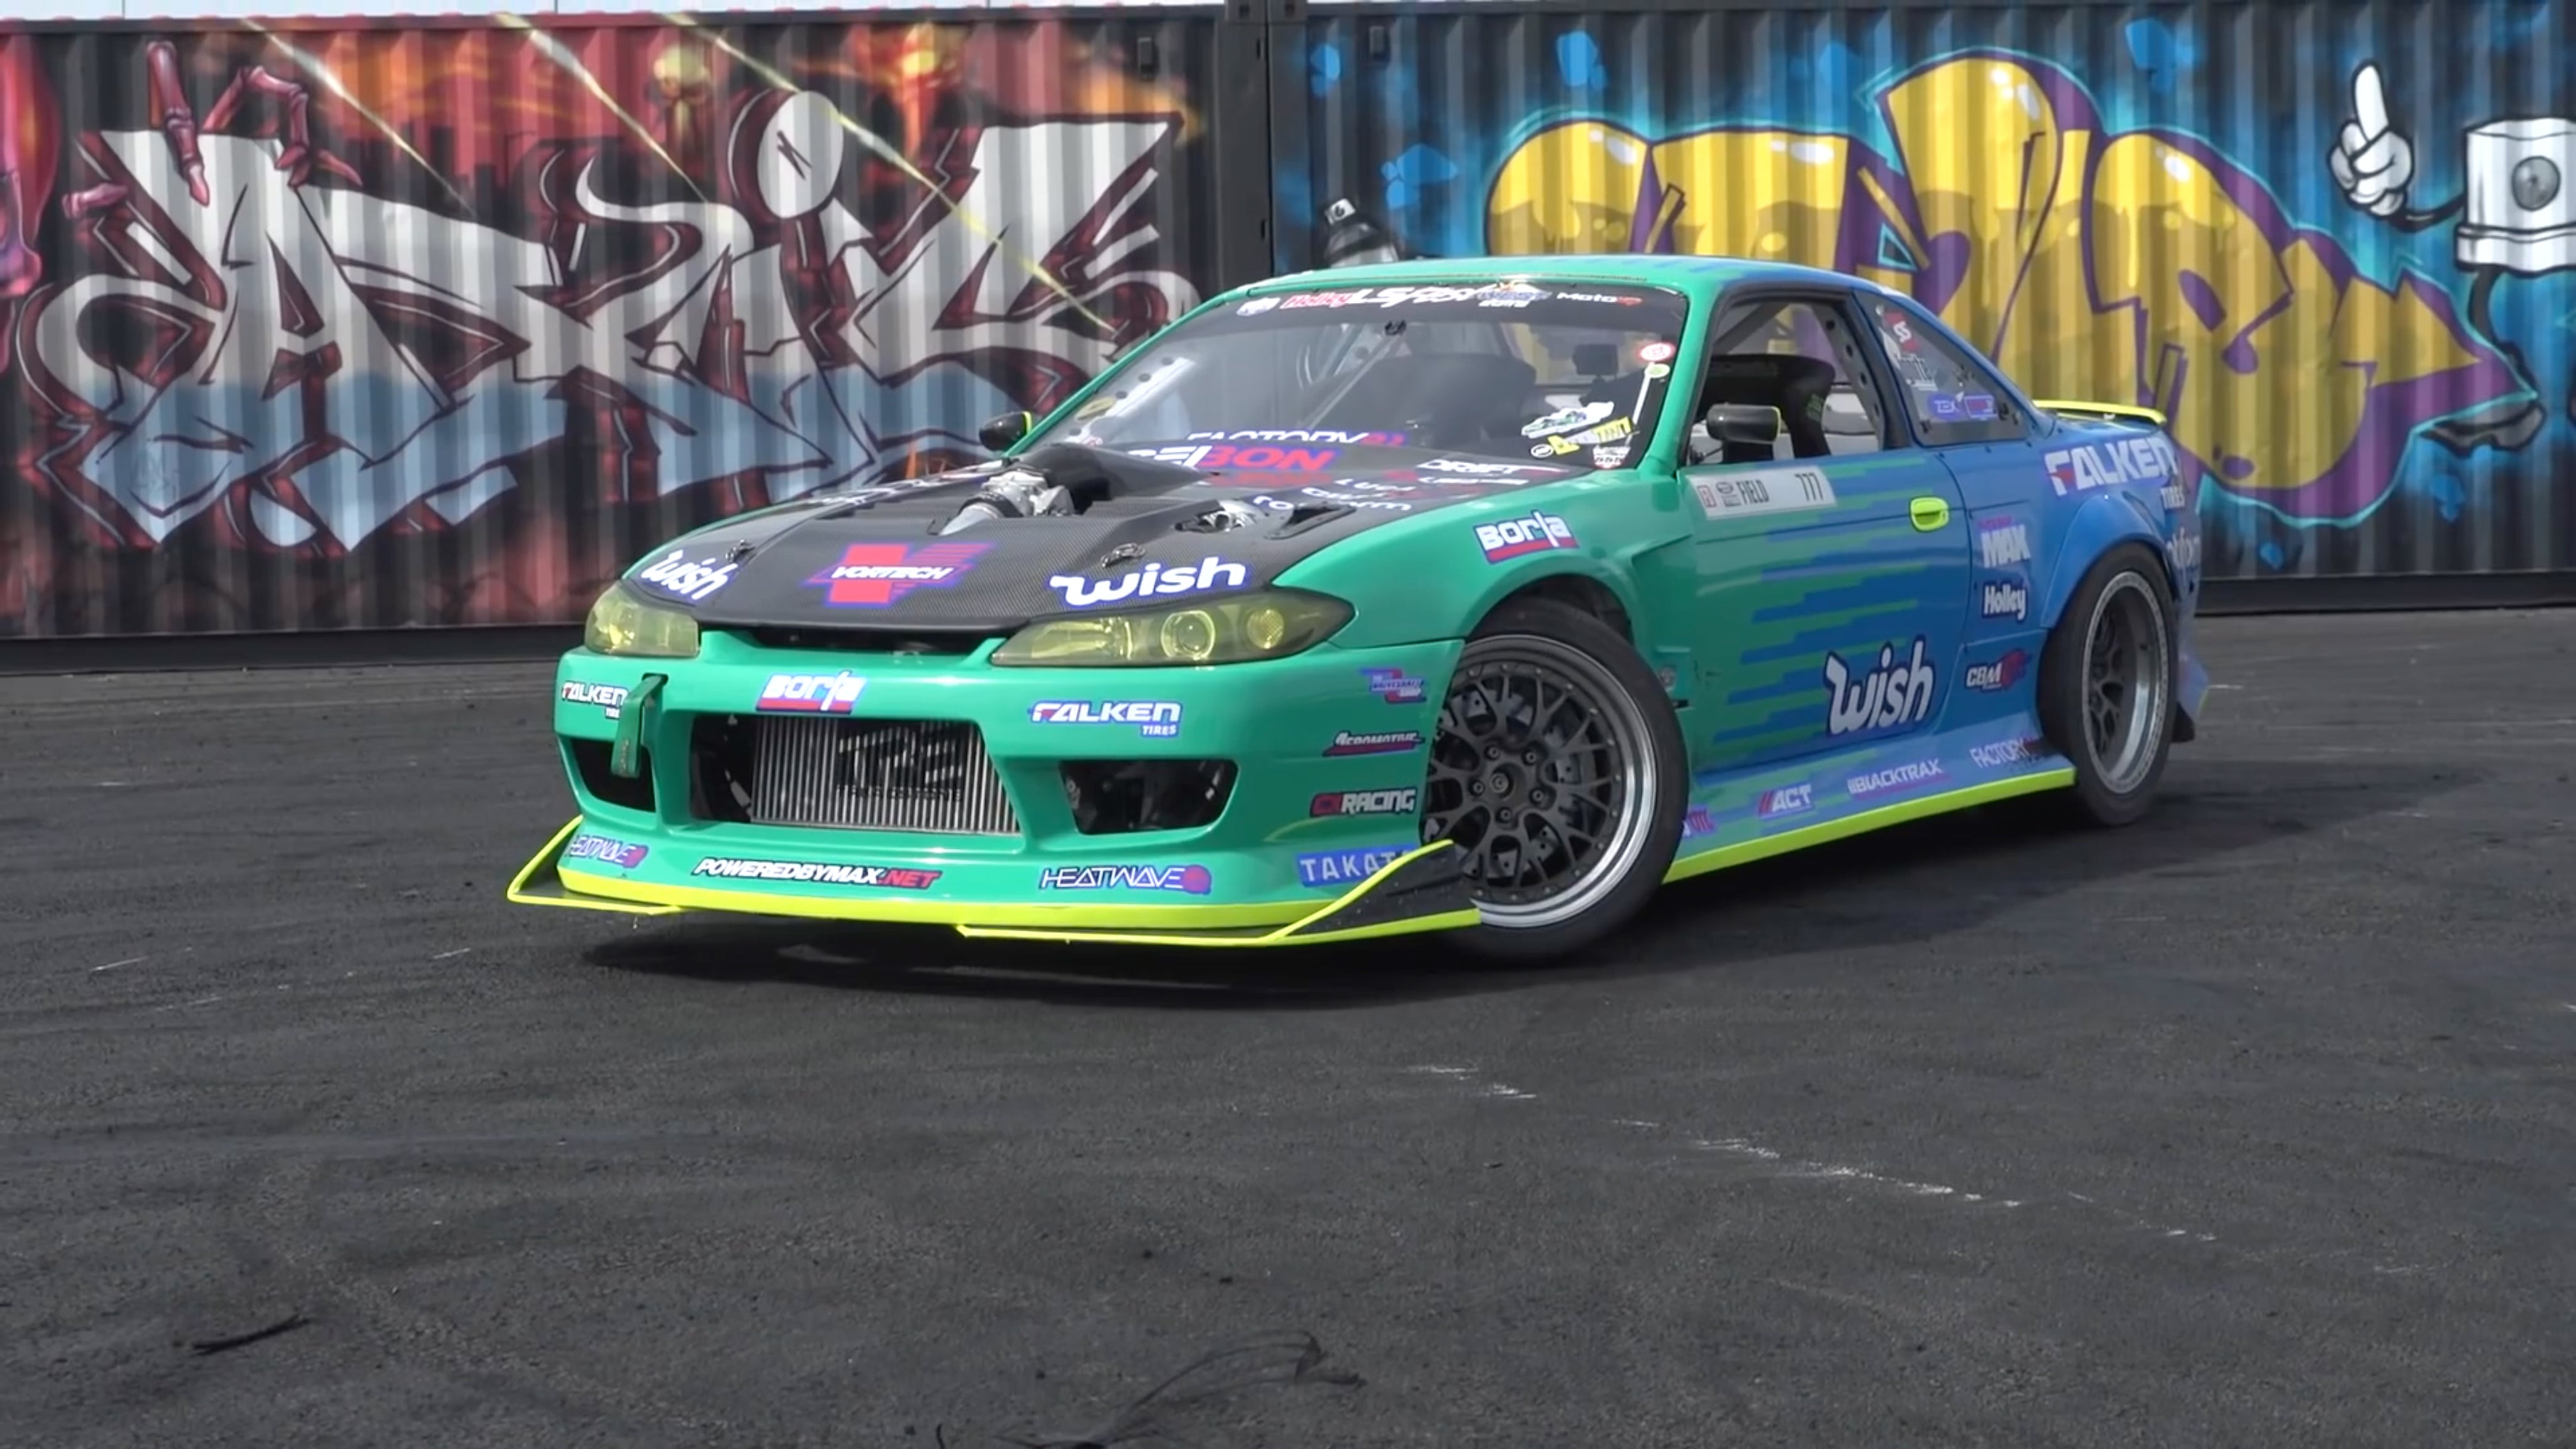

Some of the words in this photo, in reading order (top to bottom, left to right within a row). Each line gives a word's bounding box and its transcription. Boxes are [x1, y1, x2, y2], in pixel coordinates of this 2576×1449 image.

[2044, 437, 2178, 496] FALKEN
[1735, 479, 1769, 505] FIELD
[1794, 473, 1823, 501] 777
[1981, 524, 2031, 568] MAX
[831, 566, 954, 579] VORTECH
[1984, 584, 2026, 620] Holley
[1967, 662, 2002, 687] CBM
[562, 682, 628, 706] FALKEN
[1032, 702, 1181, 721] FALKEN
[1142, 725, 1177, 736] TIRES
[1969, 738, 2031, 768] FACTORY
[1341, 789, 1416, 814] RACING
[694, 858, 939, 888] POWEREDBYMAX.NET
[1041, 867, 1186, 888] HEATWAVE
[1300, 851, 1412, 882] TAKAT
